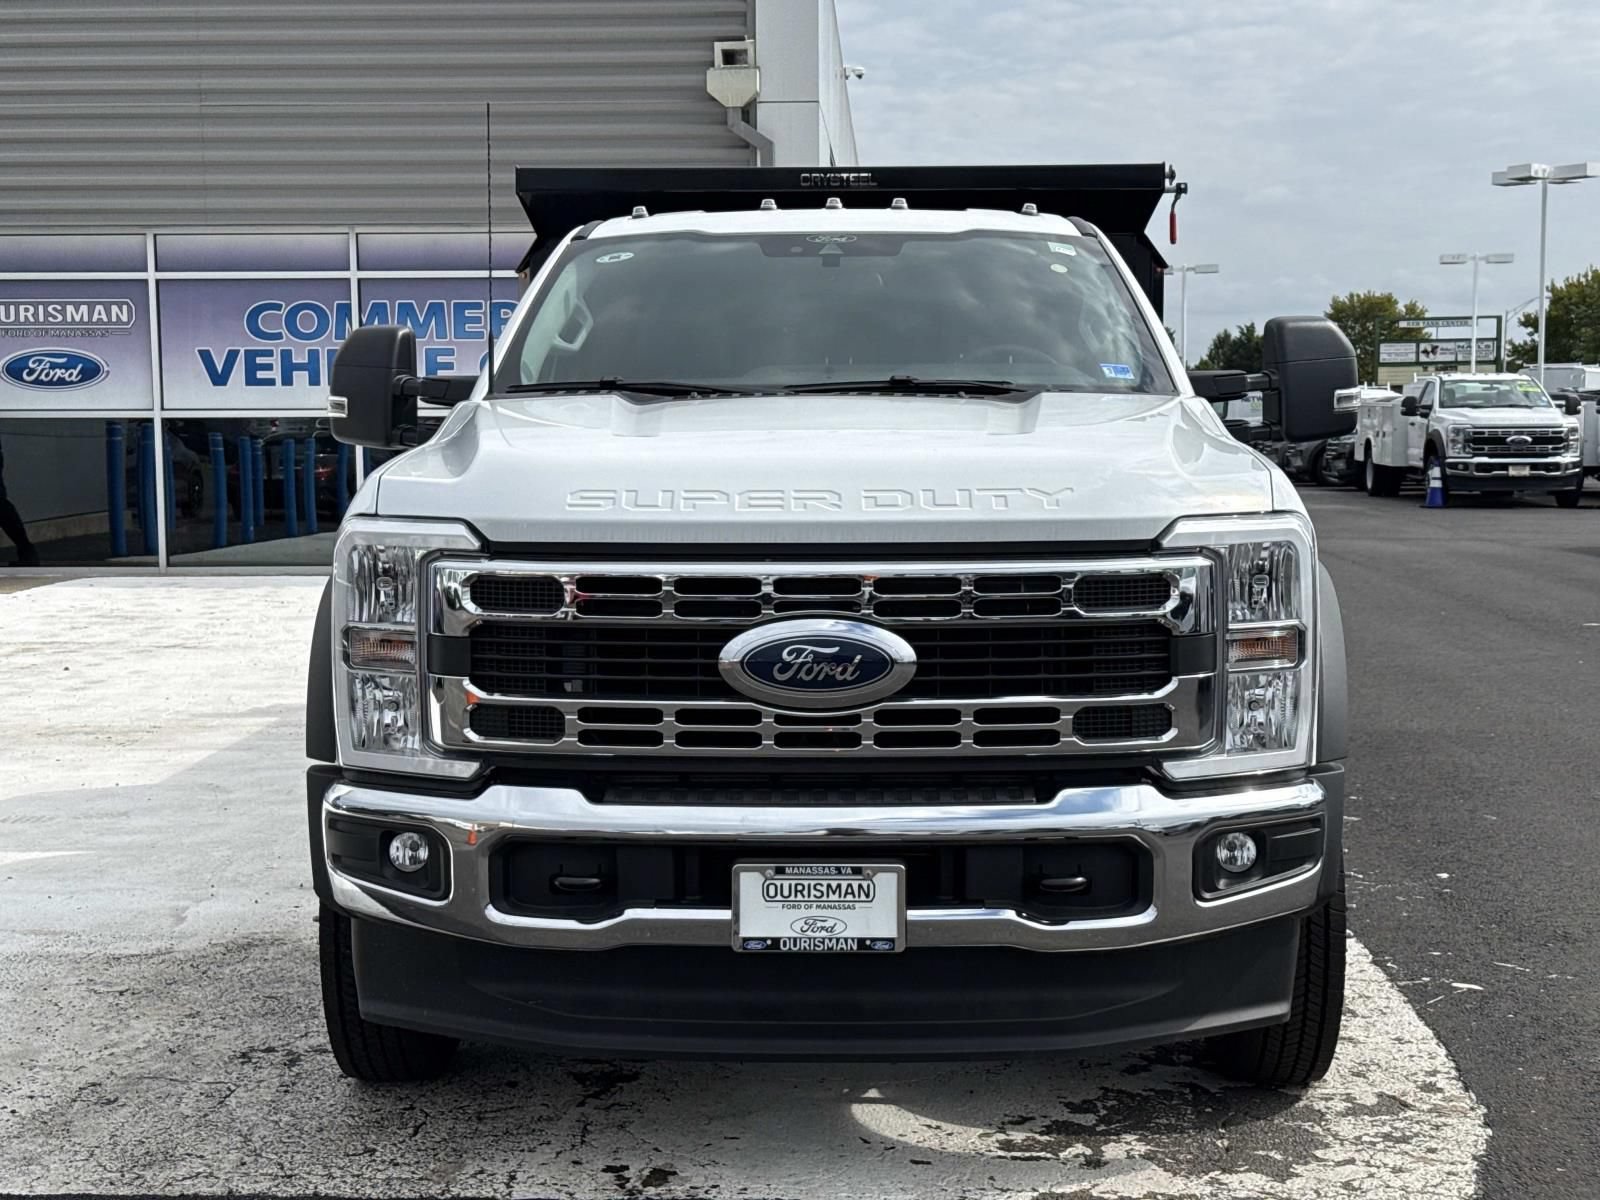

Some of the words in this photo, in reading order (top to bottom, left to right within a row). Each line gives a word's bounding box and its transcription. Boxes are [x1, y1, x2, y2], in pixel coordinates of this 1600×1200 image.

[800, 172, 878, 187] CRYSTEEL
[0, 304, 129, 324] URISMAN
[244, 301, 520, 341] COMMER
[1, 328, 31, 337] FORD
[34, 328, 46, 337] OF
[51, 328, 109, 338] MANASSAS
[22, 356, 83, 382] Ford
[565, 489, 842, 512] SUPER
[861, 487, 1074, 511] DUTY
[772, 644, 862, 681] Ford
[841, 866, 852, 875] VA
[765, 882, 871, 899] OURISMAN
[800, 918, 837, 933] Ford
[780, 938, 858, 951] OURISMAN
